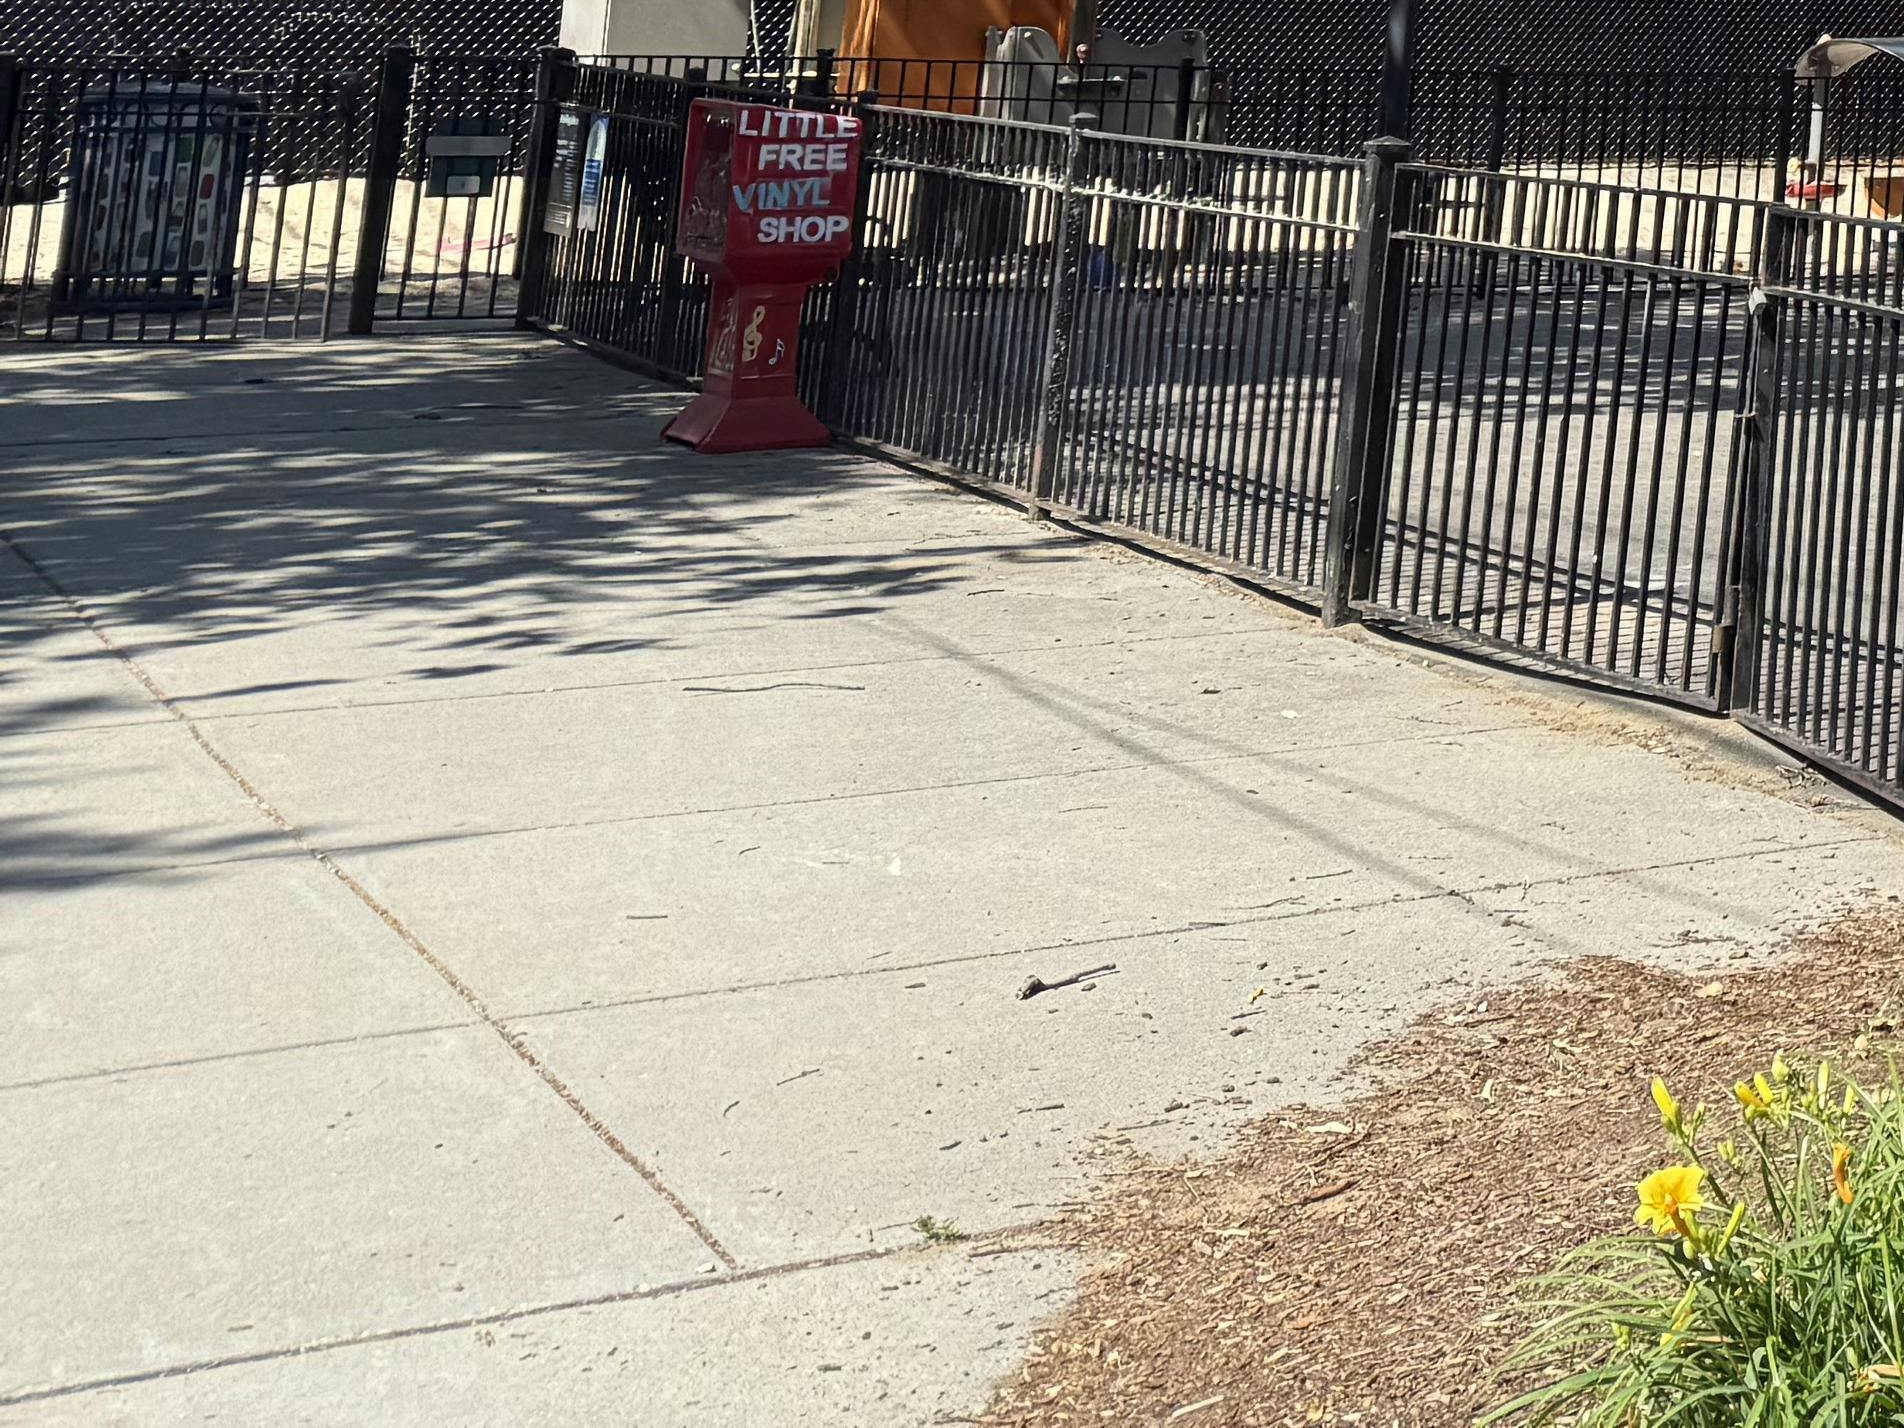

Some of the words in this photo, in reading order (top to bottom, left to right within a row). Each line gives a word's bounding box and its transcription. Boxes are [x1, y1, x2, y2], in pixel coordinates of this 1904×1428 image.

[739, 109, 858, 138] LITTLE
[758, 143, 848, 171] FREE
[732, 178, 831, 213] VINYL
[757, 215, 850, 243] SHOP
